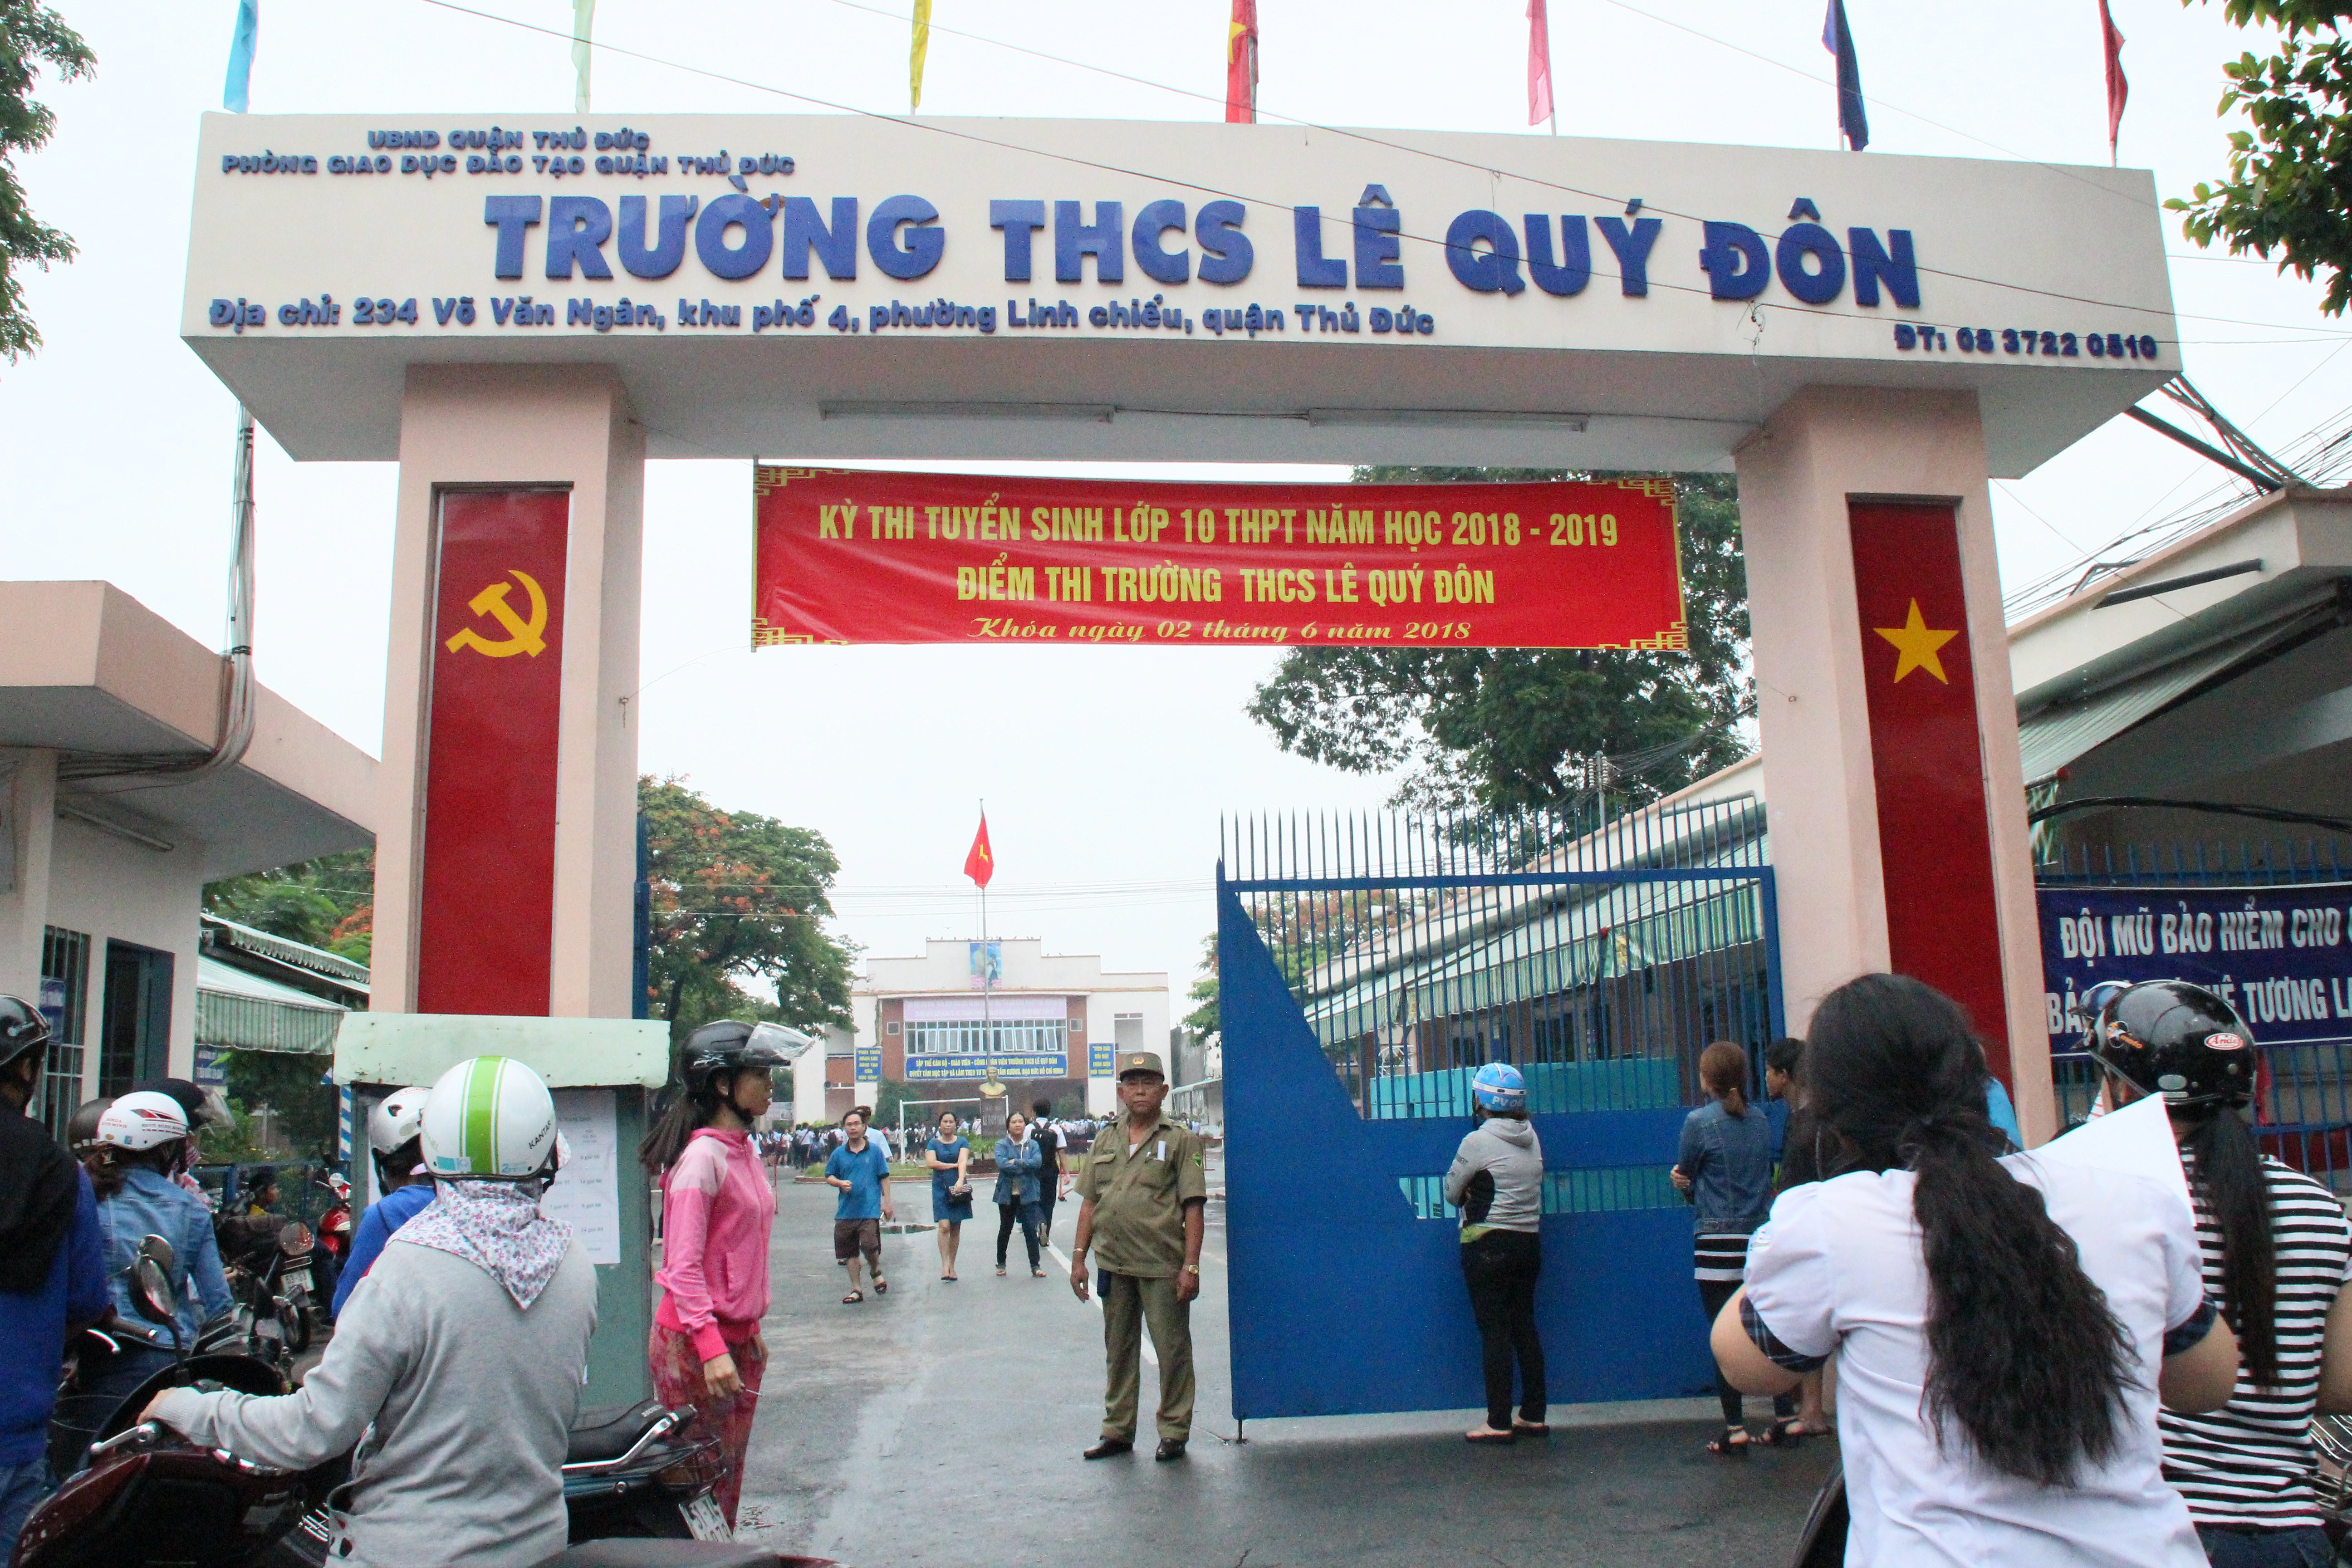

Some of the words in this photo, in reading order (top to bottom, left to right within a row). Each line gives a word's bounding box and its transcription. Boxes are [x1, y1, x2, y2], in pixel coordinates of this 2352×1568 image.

[368, 130, 440, 149] UBND
[448, 126, 524, 153] QUẬN
[532, 126, 588, 150] THỦ
[594, 127, 650, 150] ĐỨC
[222, 149, 318, 174] PHÒNG
[327, 155, 392, 174] GIAO
[401, 154, 457, 179] DỤC
[466, 148, 523, 174] ĐÀO
[532, 155, 585, 178] TẠO
[595, 151, 668, 178] QUẬN
[677, 149, 731, 175] THỦ
[739, 152, 795, 175] ĐỨC
[484, 175, 946, 280] TRƯỜNG
[990, 199, 1254, 284] THCS
[1294, 183, 1405, 289] LÊ
[1446, 197, 1662, 297] QUÝ
[1699, 197, 1922, 308] ĐÔN
[209, 297, 266, 333] Địa
[278, 293, 340, 326] chỉ:
[353, 297, 419, 324] 234
[432, 296, 475, 326] Võ
[490, 296, 555, 326] Văn
[566, 297, 665, 332] Ngân,
[677, 298, 741, 327] khu
[752, 294, 818, 331] phố
[828, 304, 859, 332] 4,
[869, 297, 996, 332] phường
[1008, 297, 1079, 328] Linh
[1202, 303, 1285, 338] quận
[1294, 300, 1360, 333] Thủ
[1370, 304, 1434, 334] Đức
[1894, 323, 1947, 352] ĐT:
[1956, 327, 1995, 354] 08
[2003, 328, 2080, 357] 3722
[2087, 333, 2158, 360] 0510
[819, 498, 859, 540] KỲ
[867, 506, 915, 540] THI
[924, 492, 1021, 541] TUYỂN
[1031, 507, 1104, 542] SINH
[1114, 500, 1170, 544] LỚP
[1180, 509, 1216, 544] 10
[1225, 509, 1298, 544] THPT
[1306, 503, 1375, 544] NĂM
[1384, 510, 1443, 553] HỌC
[1451, 512, 1521, 547] 2018
[1550, 513, 1618, 547] 2019
[956, 552, 1036, 602] ĐIỂM
[1044, 566, 1092, 603] THI
[1101, 559, 1222, 603] TRƯỜNG
[1240, 568, 1317, 603] THCS
[1325, 562, 1359, 603] LÊ
[1368, 563, 1425, 608] QUÝ
[1433, 563, 1495, 604] ĐÔN
[966, 617, 1059, 638] Khóa
[1068, 622, 1146, 642] ngày
[1157, 621, 1192, 638] 02
[1202, 620, 1291, 642] tháng
[1301, 621, 1317, 639] 6
[1327, 623, 1393, 639] năm
[1402, 622, 1471, 639] 2018
[2059, 907, 2106, 967] ĐỘI
[2111, 906, 2155, 956] MŨ
[2161, 900, 2213, 954] BẢO
[2219, 895, 2284, 951] HIỂM
[2291, 907, 2341, 948] CHO
[2242, 976, 2329, 1024] TƯƠNG
